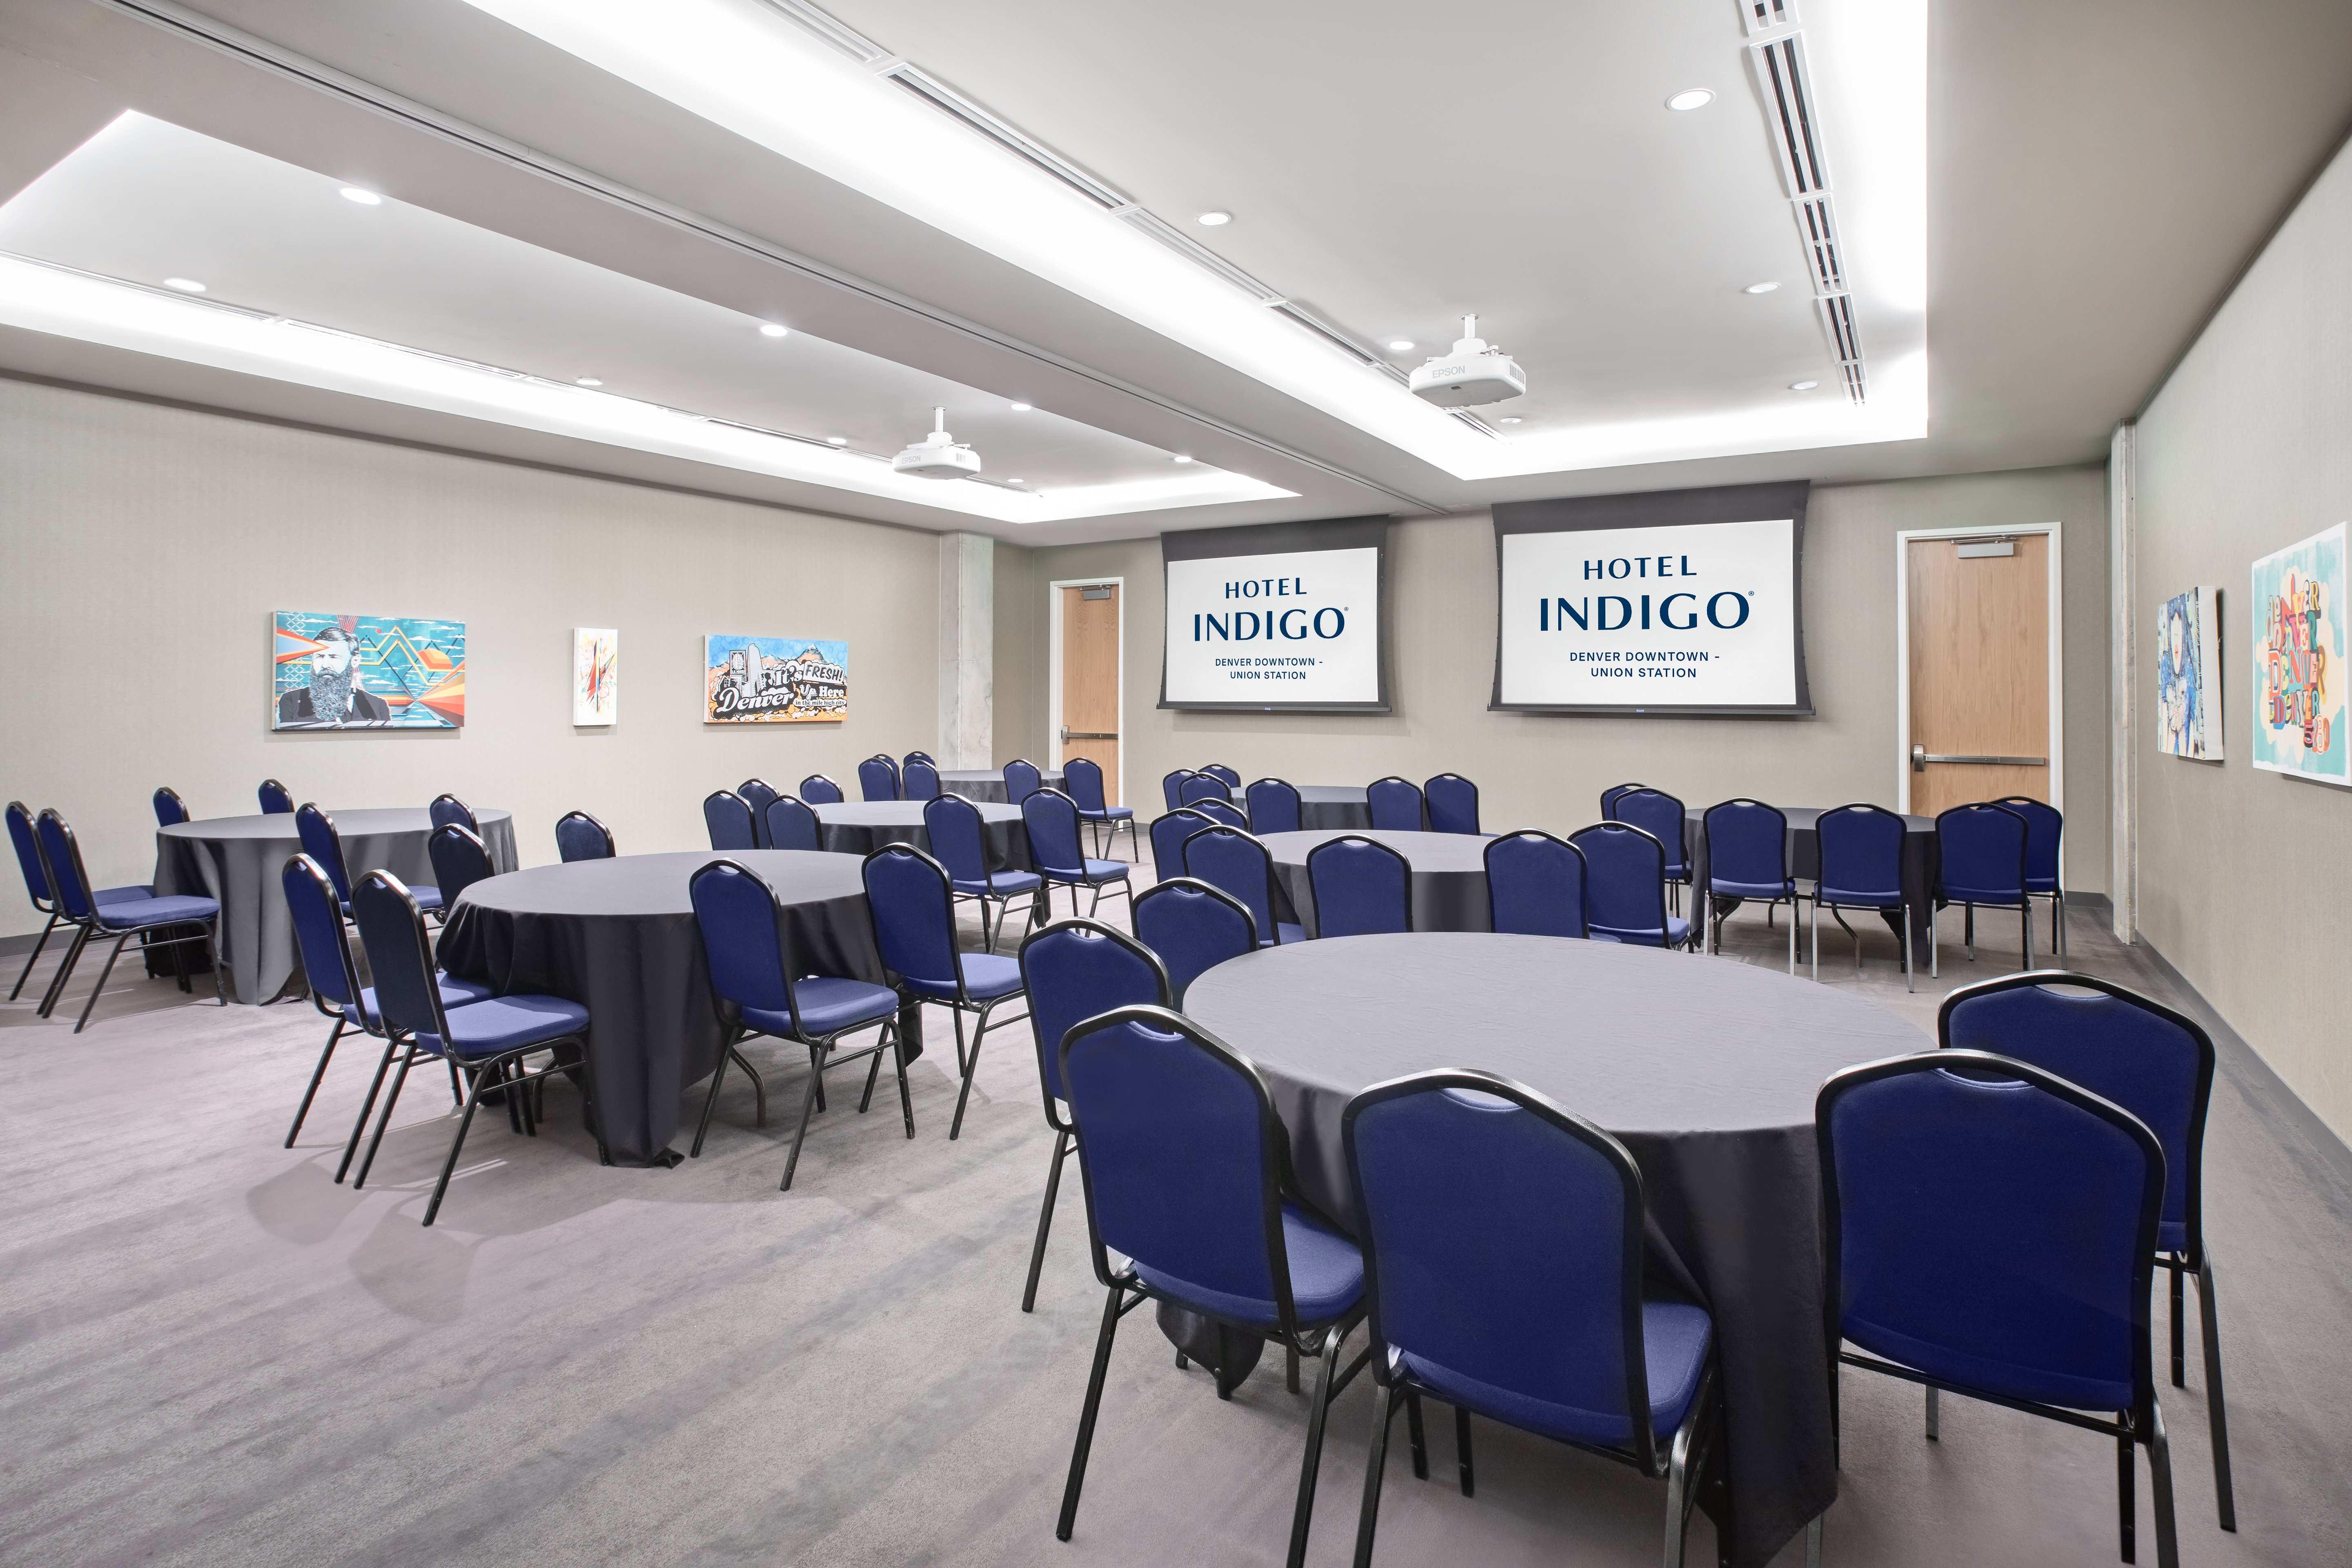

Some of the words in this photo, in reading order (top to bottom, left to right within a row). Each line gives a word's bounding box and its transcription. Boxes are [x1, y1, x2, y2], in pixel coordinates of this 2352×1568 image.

[1432, 365, 1466, 379] EPSON
[902, 455, 921, 464] EPSON
[1584, 555, 1697, 580] HOTEL
[1225, 577, 1307, 599] HOTEL
[1255, 657, 1314, 666] DOWNTOWN
[1570, 652, 1620, 662] DENVER
[1626, 651, 1708, 662] DOWNTOWN
[775, 666, 803, 686] It's
[805, 664, 844, 682] FRESH!
[1264, 671, 1305, 679] STATION
[1591, 668, 1633, 677] UNION
[1638, 668, 1696, 678] STATION
[799, 684, 818, 700] Up
[818, 686, 844, 697] Here
[716, 687, 794, 713] Denver
[2303, 715, 2330, 754] 5280
